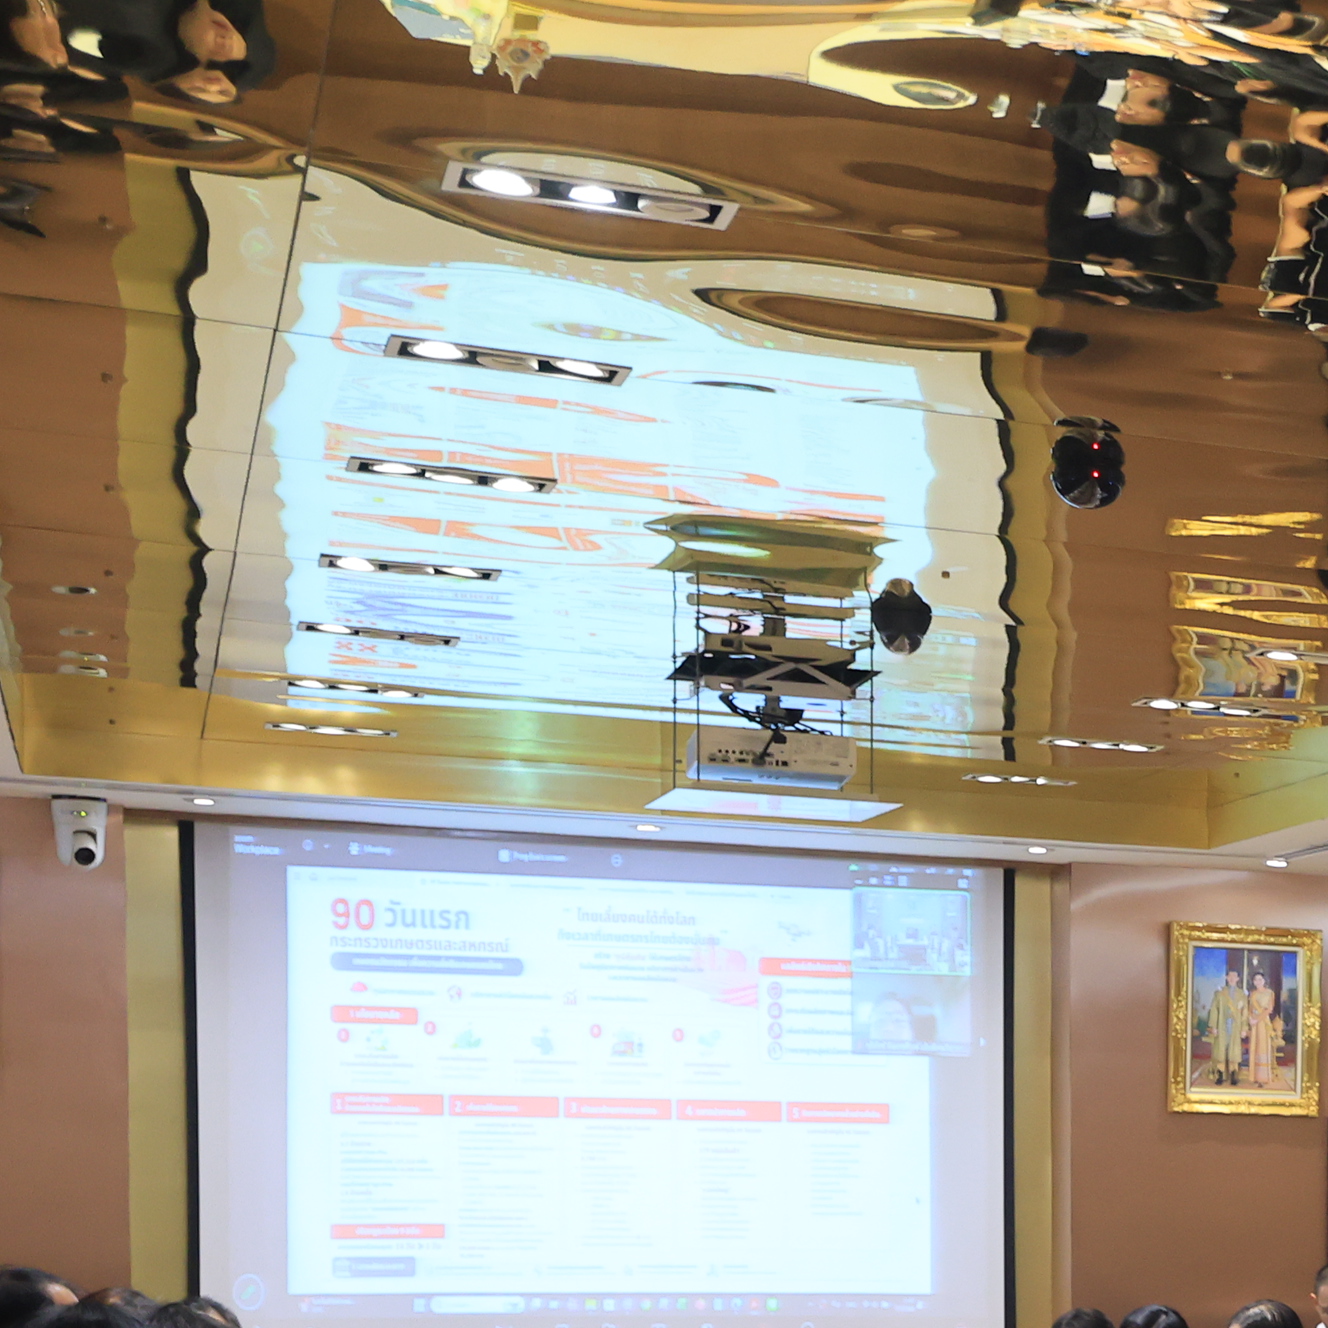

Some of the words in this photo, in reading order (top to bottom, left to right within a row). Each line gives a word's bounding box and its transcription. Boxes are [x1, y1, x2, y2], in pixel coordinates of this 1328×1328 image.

[331, 898, 375, 930] 90
[384, 899, 471, 931] วันแรก
[330, 934, 510, 954] กระทรวงเกษตรและสหกรณ์
